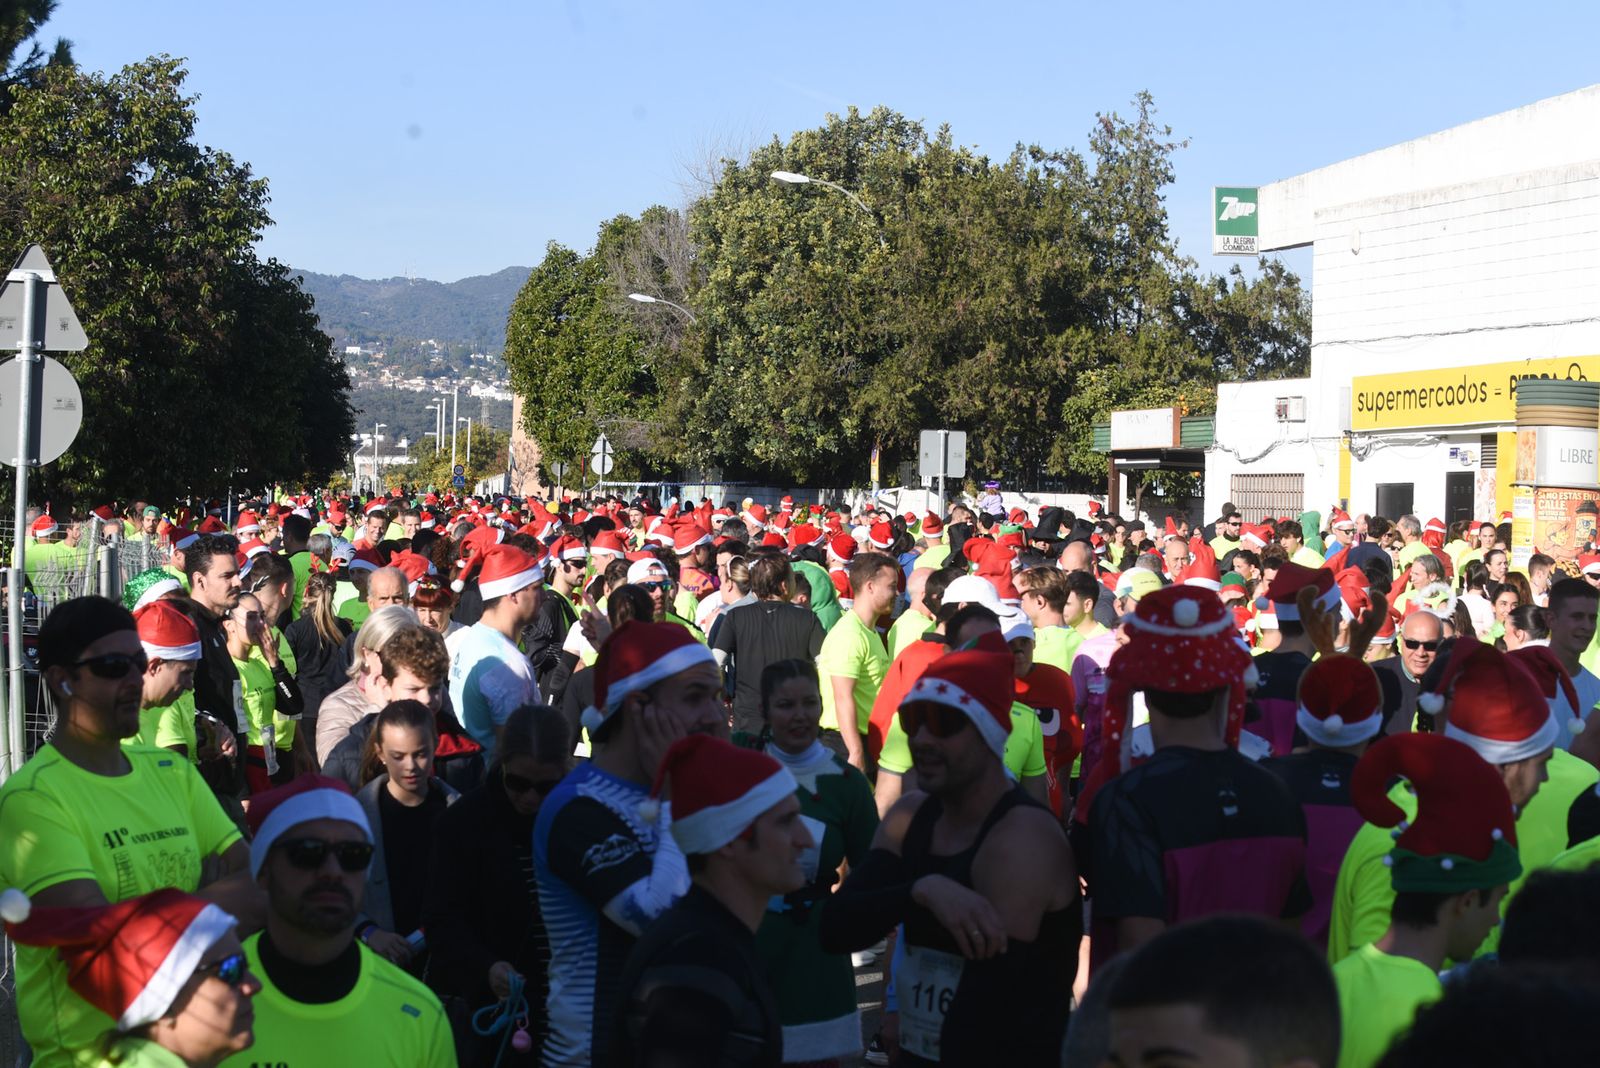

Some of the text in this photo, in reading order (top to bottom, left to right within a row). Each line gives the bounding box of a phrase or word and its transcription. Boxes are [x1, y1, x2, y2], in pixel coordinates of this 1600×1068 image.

[1233, 237, 1255, 245] ALEGRIA
[1357, 374, 1487, 422] supermercados
[1560, 447, 1594, 465] LIBRE
[1583, 492, 1592, 500] EN
